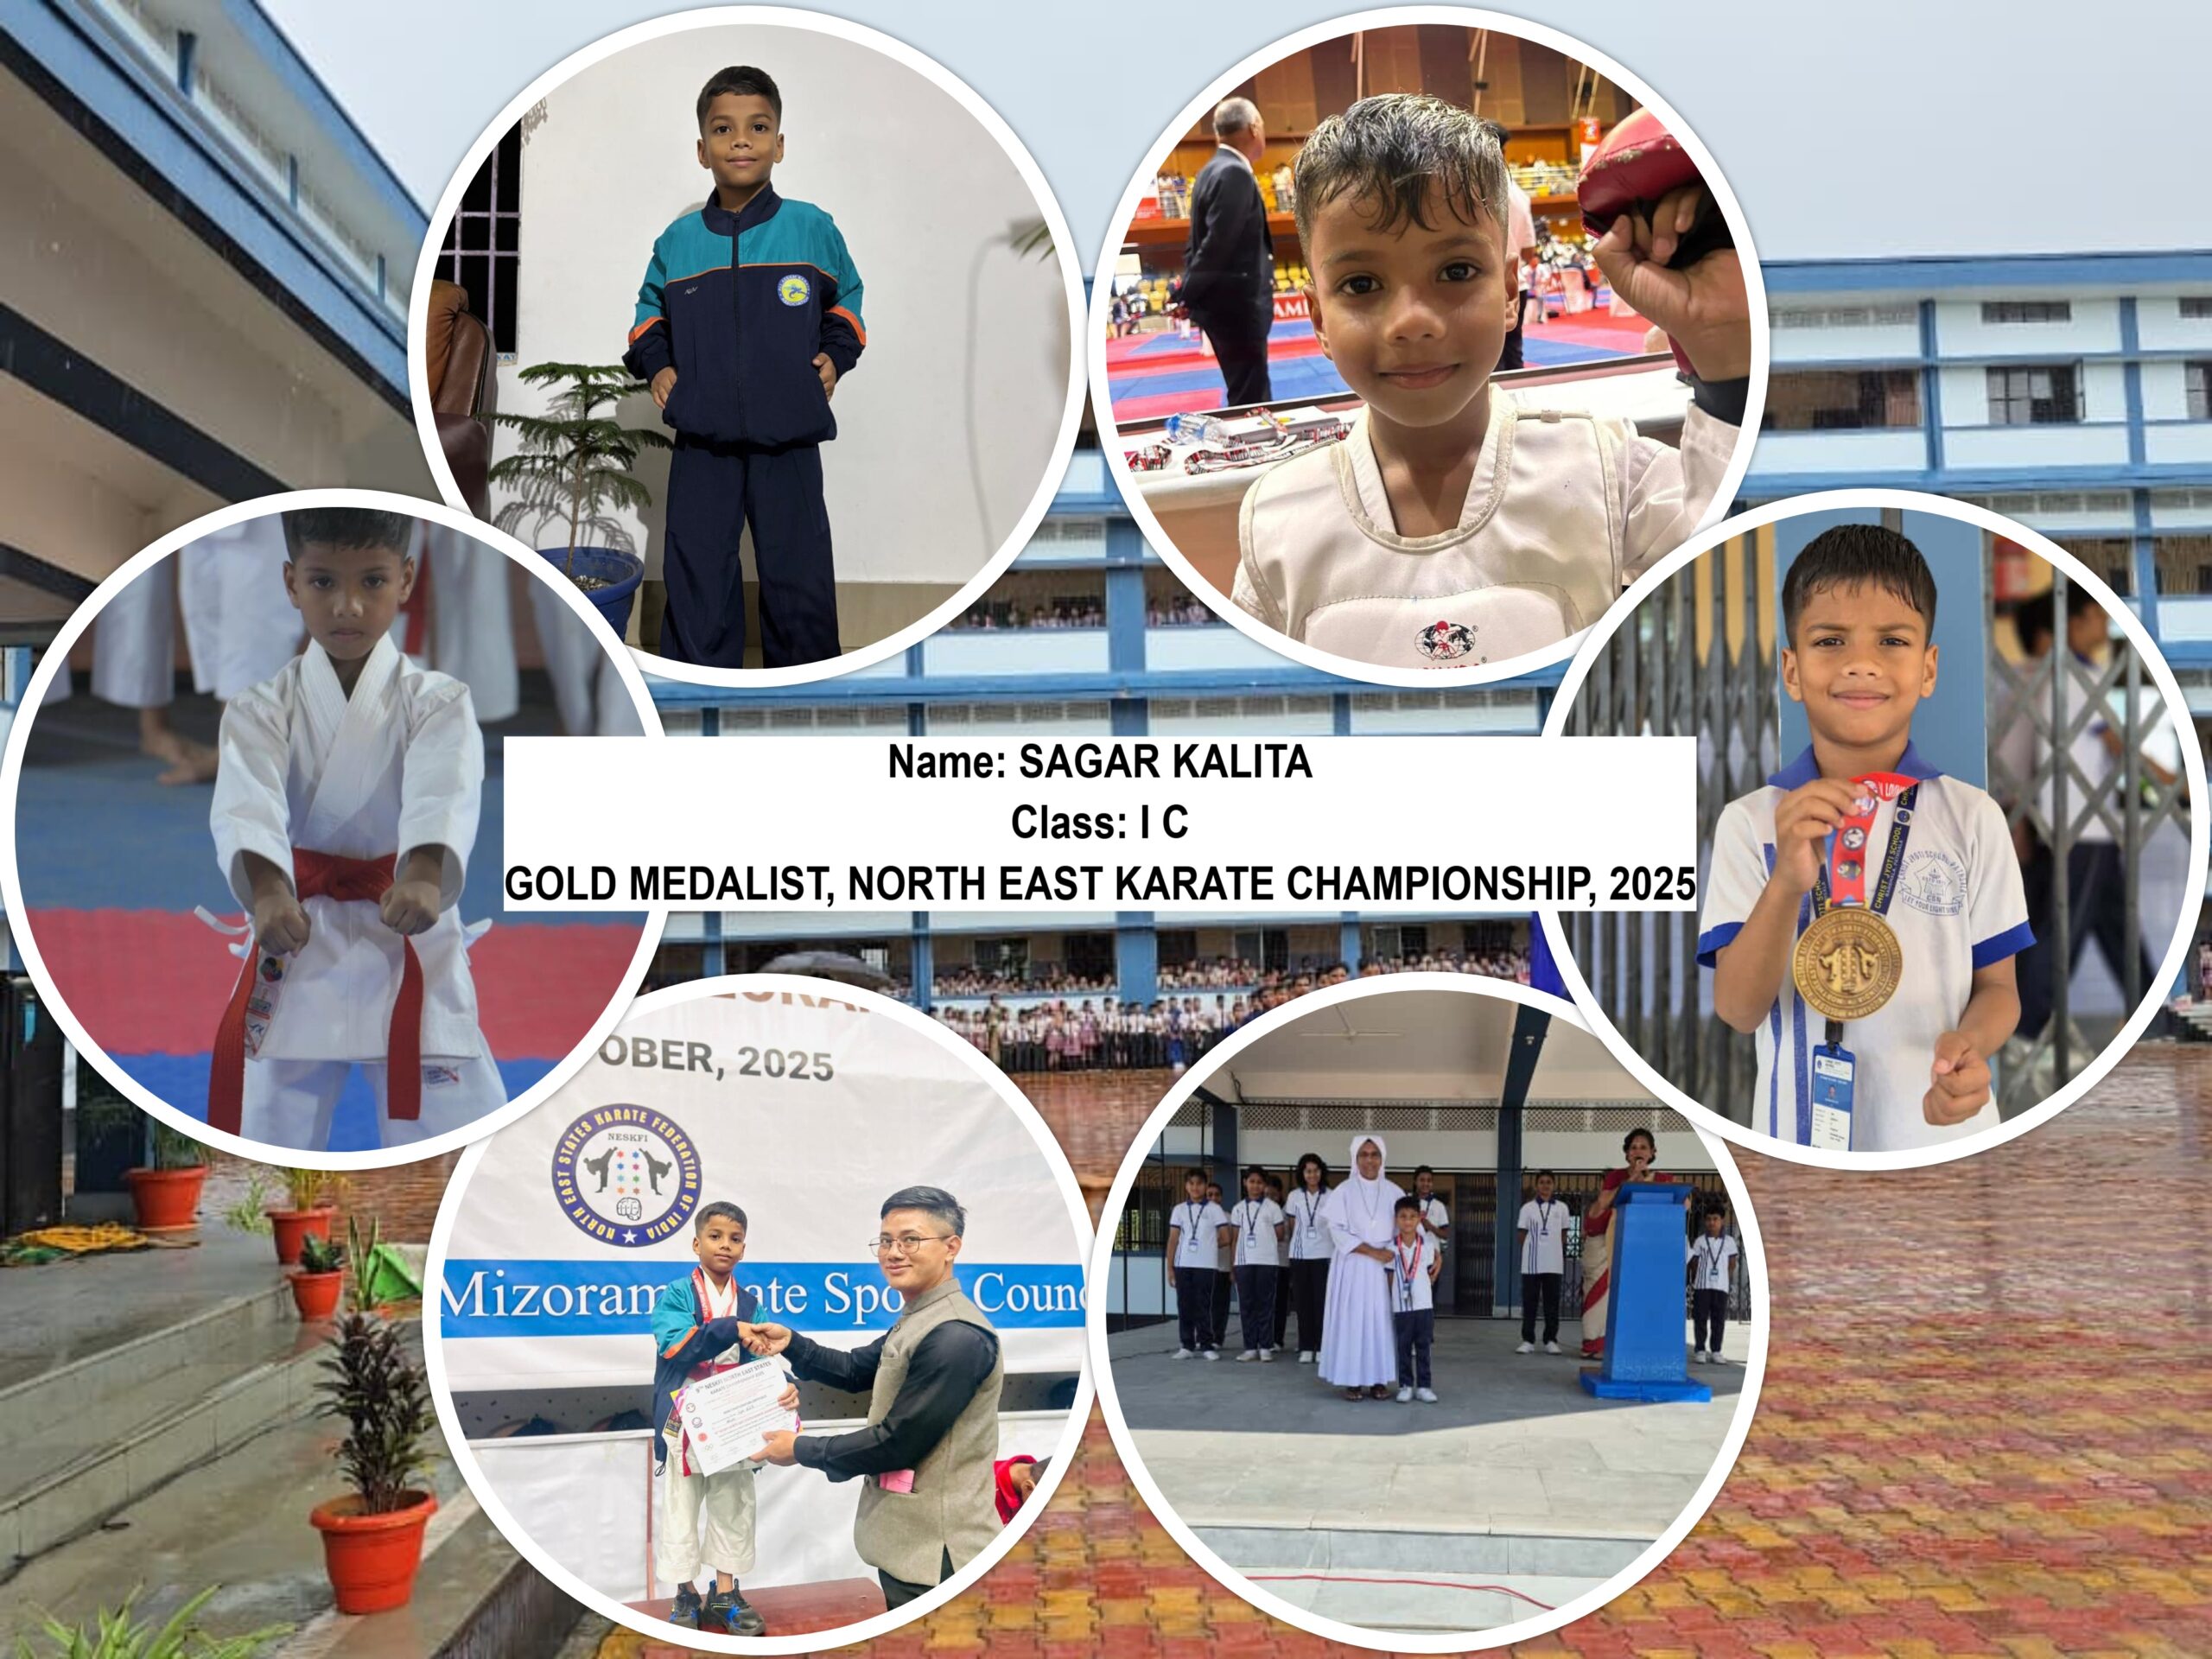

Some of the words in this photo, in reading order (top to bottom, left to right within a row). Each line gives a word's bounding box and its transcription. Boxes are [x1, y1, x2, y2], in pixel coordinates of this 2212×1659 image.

[1874, 880, 1889, 908] CHRIST
[1884, 855, 1895, 878] JYOTI
[1890, 826, 1902, 855] SCHOOL
[1915, 899, 1929, 911] YOUR
[598, 1034, 725, 1082] OBER,
[738, 1046, 835, 1082] 2025
[594, 1109, 648, 1126] KARATE
[558, 1121, 593, 1165] STATES
[607, 1133, 648, 1142] NESKFI
[651, 1116, 698, 1190] FEDERATION
[557, 1171, 577, 1205] EAST
[679, 1194, 695, 1211] OF
[572, 1207, 616, 1241] NORTH
[646, 1211, 683, 1240] INDIA
[441, 1268, 666, 1317] Mizoram
[744, 1277, 808, 1314] ate
[824, 1272, 904, 1325] Spo
[741, 1367, 753, 1376] EAST
[753, 1361, 772, 1370] STATES
